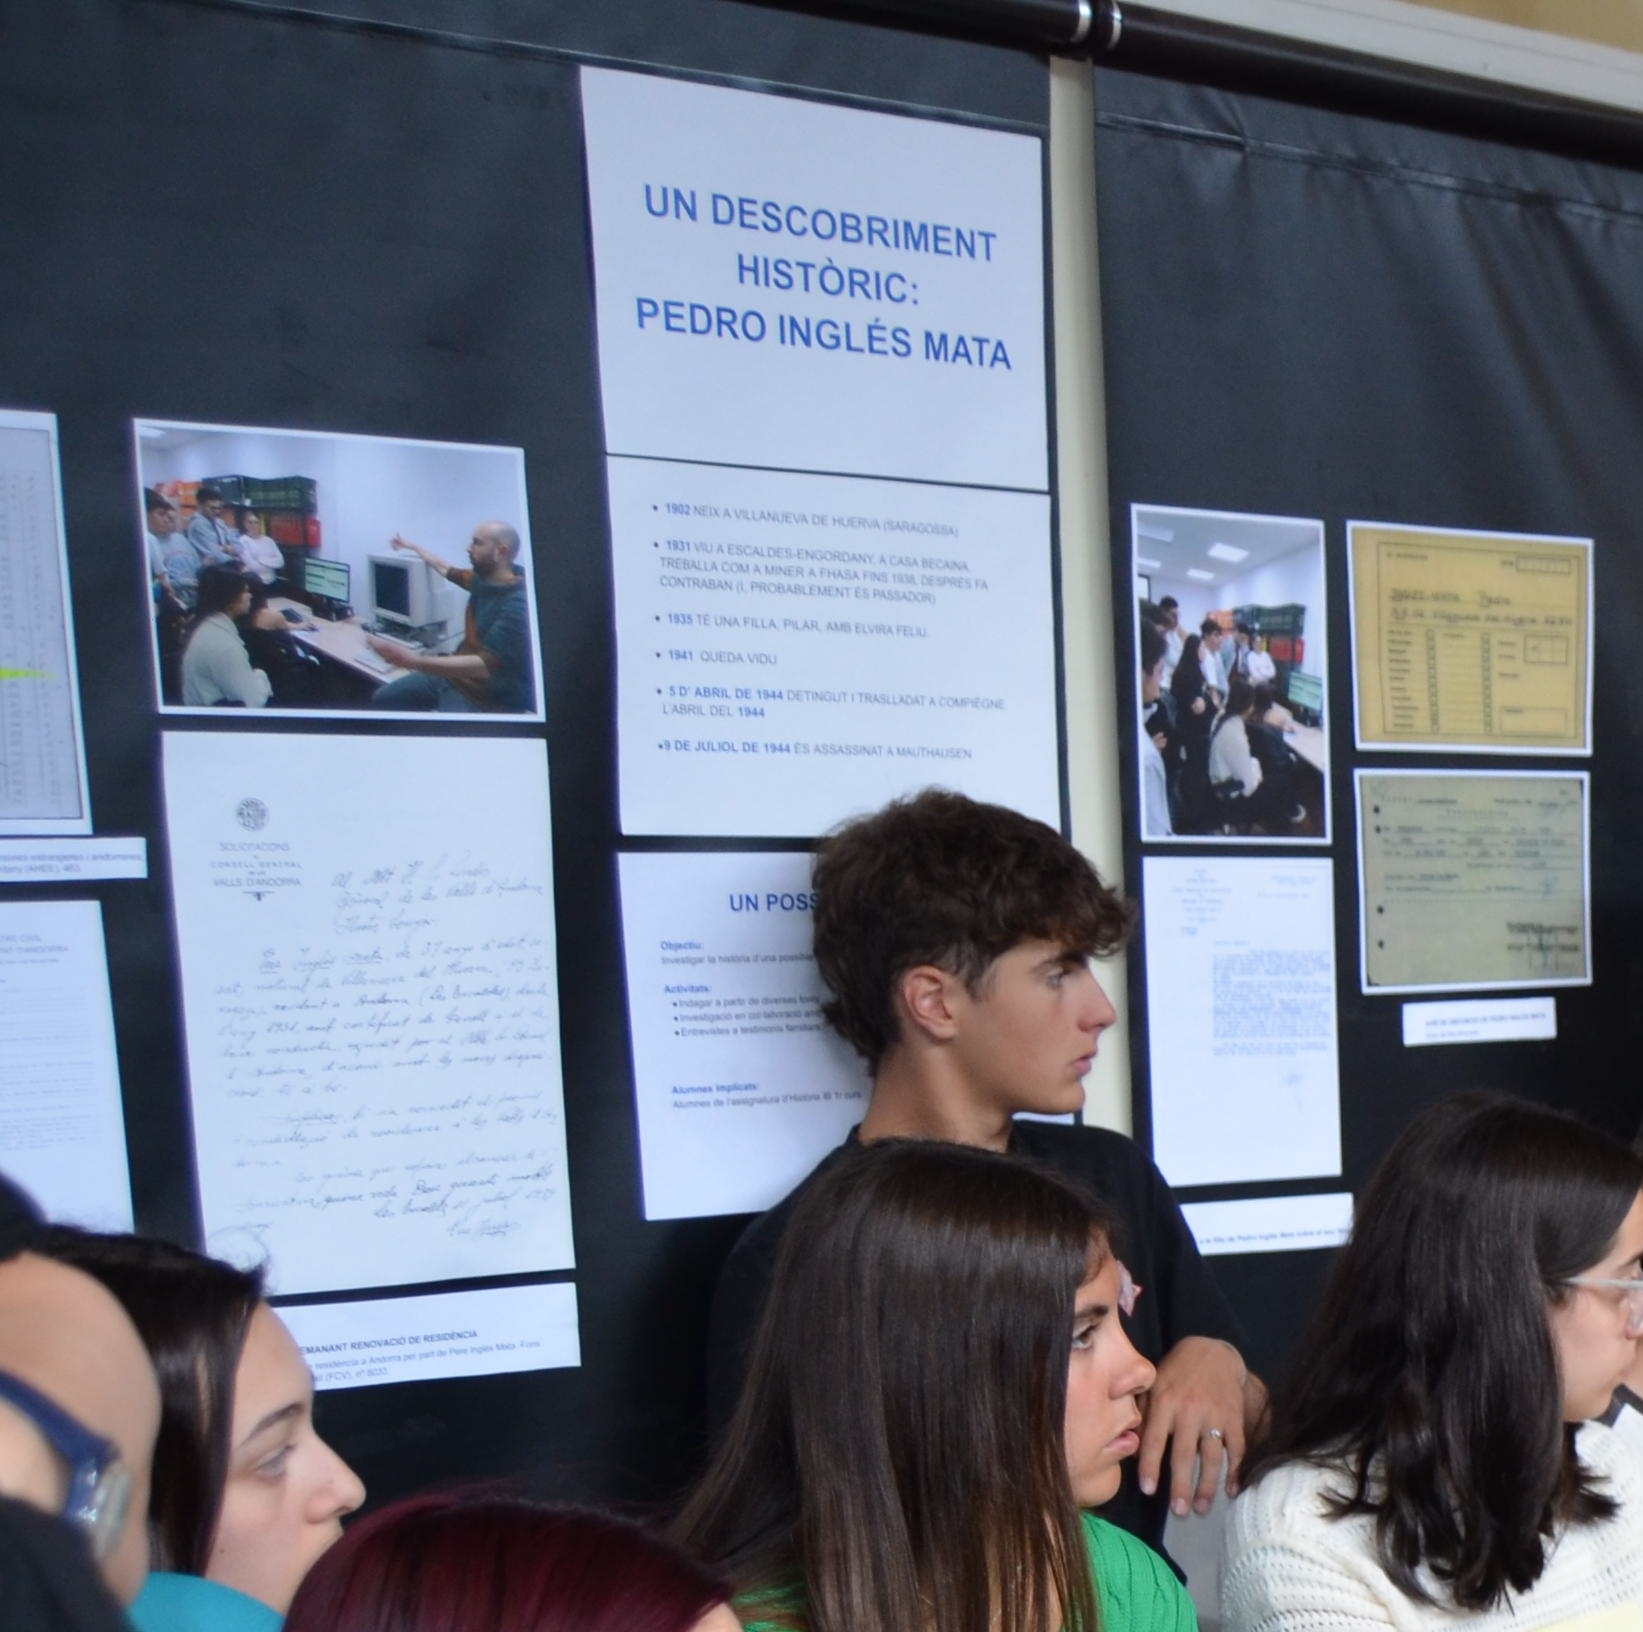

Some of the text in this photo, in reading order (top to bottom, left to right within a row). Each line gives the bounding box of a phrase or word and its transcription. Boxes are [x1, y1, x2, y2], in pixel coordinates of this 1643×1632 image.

[644, 184, 997, 262] UN DESCOBRIMENT
[737, 253, 919, 305] HISTÒRIC:
[636, 297, 1013, 370] PEDRO INGLÉS MATA
[666, 502, 959, 539] 1902 NEIX A VILLANUEVA DE HUERVA (SARAGOSSA)
[666, 539, 691, 553] 1931
[694, 541, 714, 554] VIU
[716, 543, 725, 555] A
[879, 554, 889, 565] A
[889, 555, 919, 568] CASA
[660, 556, 718, 572] TREBALLA
[721, 560, 750, 575] COM
[753, 563, 764, 575] A
[765, 563, 804, 579] MINER
[807, 568, 817, 580] A
[863, 570, 888, 584] FINS
[660, 574, 733, 592] CONTRABAN
[750, 580, 851, 600] PROBABLEMENT
[873, 588, 937, 607] PASSADOR)
[668, 612, 694, 625] 1935
[714, 615, 740, 628] UNA
[826, 621, 853, 634] AMB
[855, 621, 894, 635] ELVIRA
[668, 649, 778, 666] 1941 QUEDA VIDU
[669, 685, 676, 698] 5
[694, 685, 732, 700] ABRIL
[734, 687, 753, 701] DE
[756, 688, 784, 702] 1944
[787, 688, 848, 704] DETINGUT
[858, 692, 926, 708] TRASLLADAT
[928, 695, 938, 707] A
[710, 705, 735, 718] DEL
[738, 706, 766, 719] 1944
[675, 739, 691, 753] DE
[695, 739, 738, 754] JULIOL
[741, 741, 759, 754] DE
[763, 742, 791, 755] 1944
[812, 744, 883, 759] ASSASSINAT
[886, 747, 895, 759] A
[896, 747, 973, 762] MAUTHAUSEN
[729, 893, 760, 912] UN
